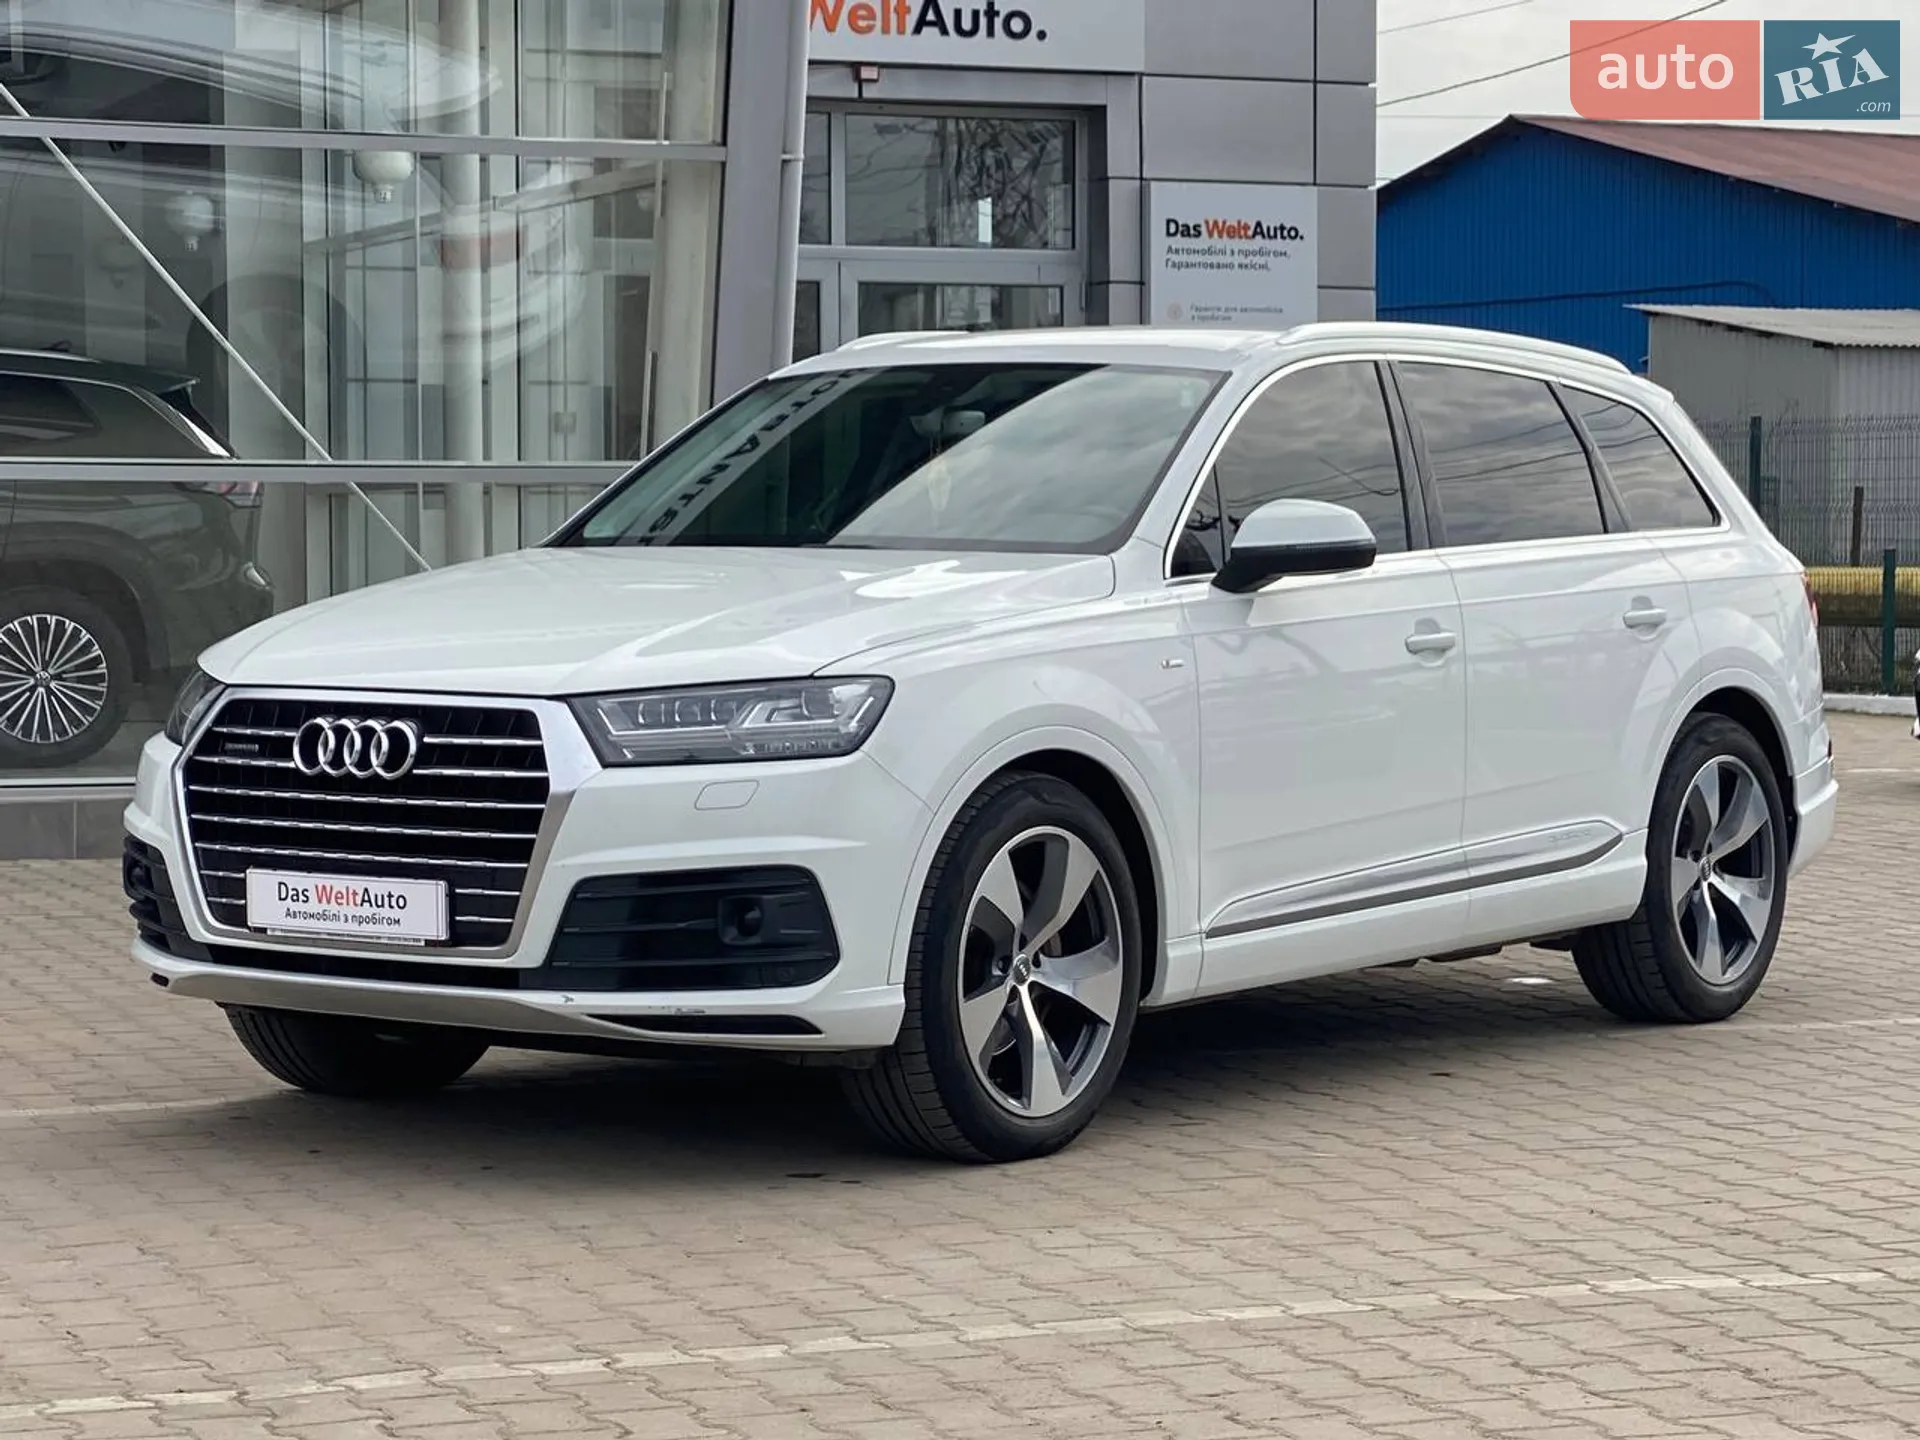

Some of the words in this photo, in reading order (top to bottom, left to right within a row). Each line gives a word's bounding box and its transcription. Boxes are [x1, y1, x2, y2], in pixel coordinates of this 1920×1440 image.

[1165, 218, 1202, 239] Das
[1204, 219, 1305, 241] WeltAuto.
[1166, 245, 1227, 257] Автомобілі
[1230, 249, 1236, 257] з
[1165, 258, 1235, 271] Гарантовано
[277, 881, 310, 903] Das
[315, 884, 408, 910] WeltAuto
[285, 907, 341, 924] Автомобілі
[343, 913, 349, 924] з
[351, 911, 401, 927] пробігом
